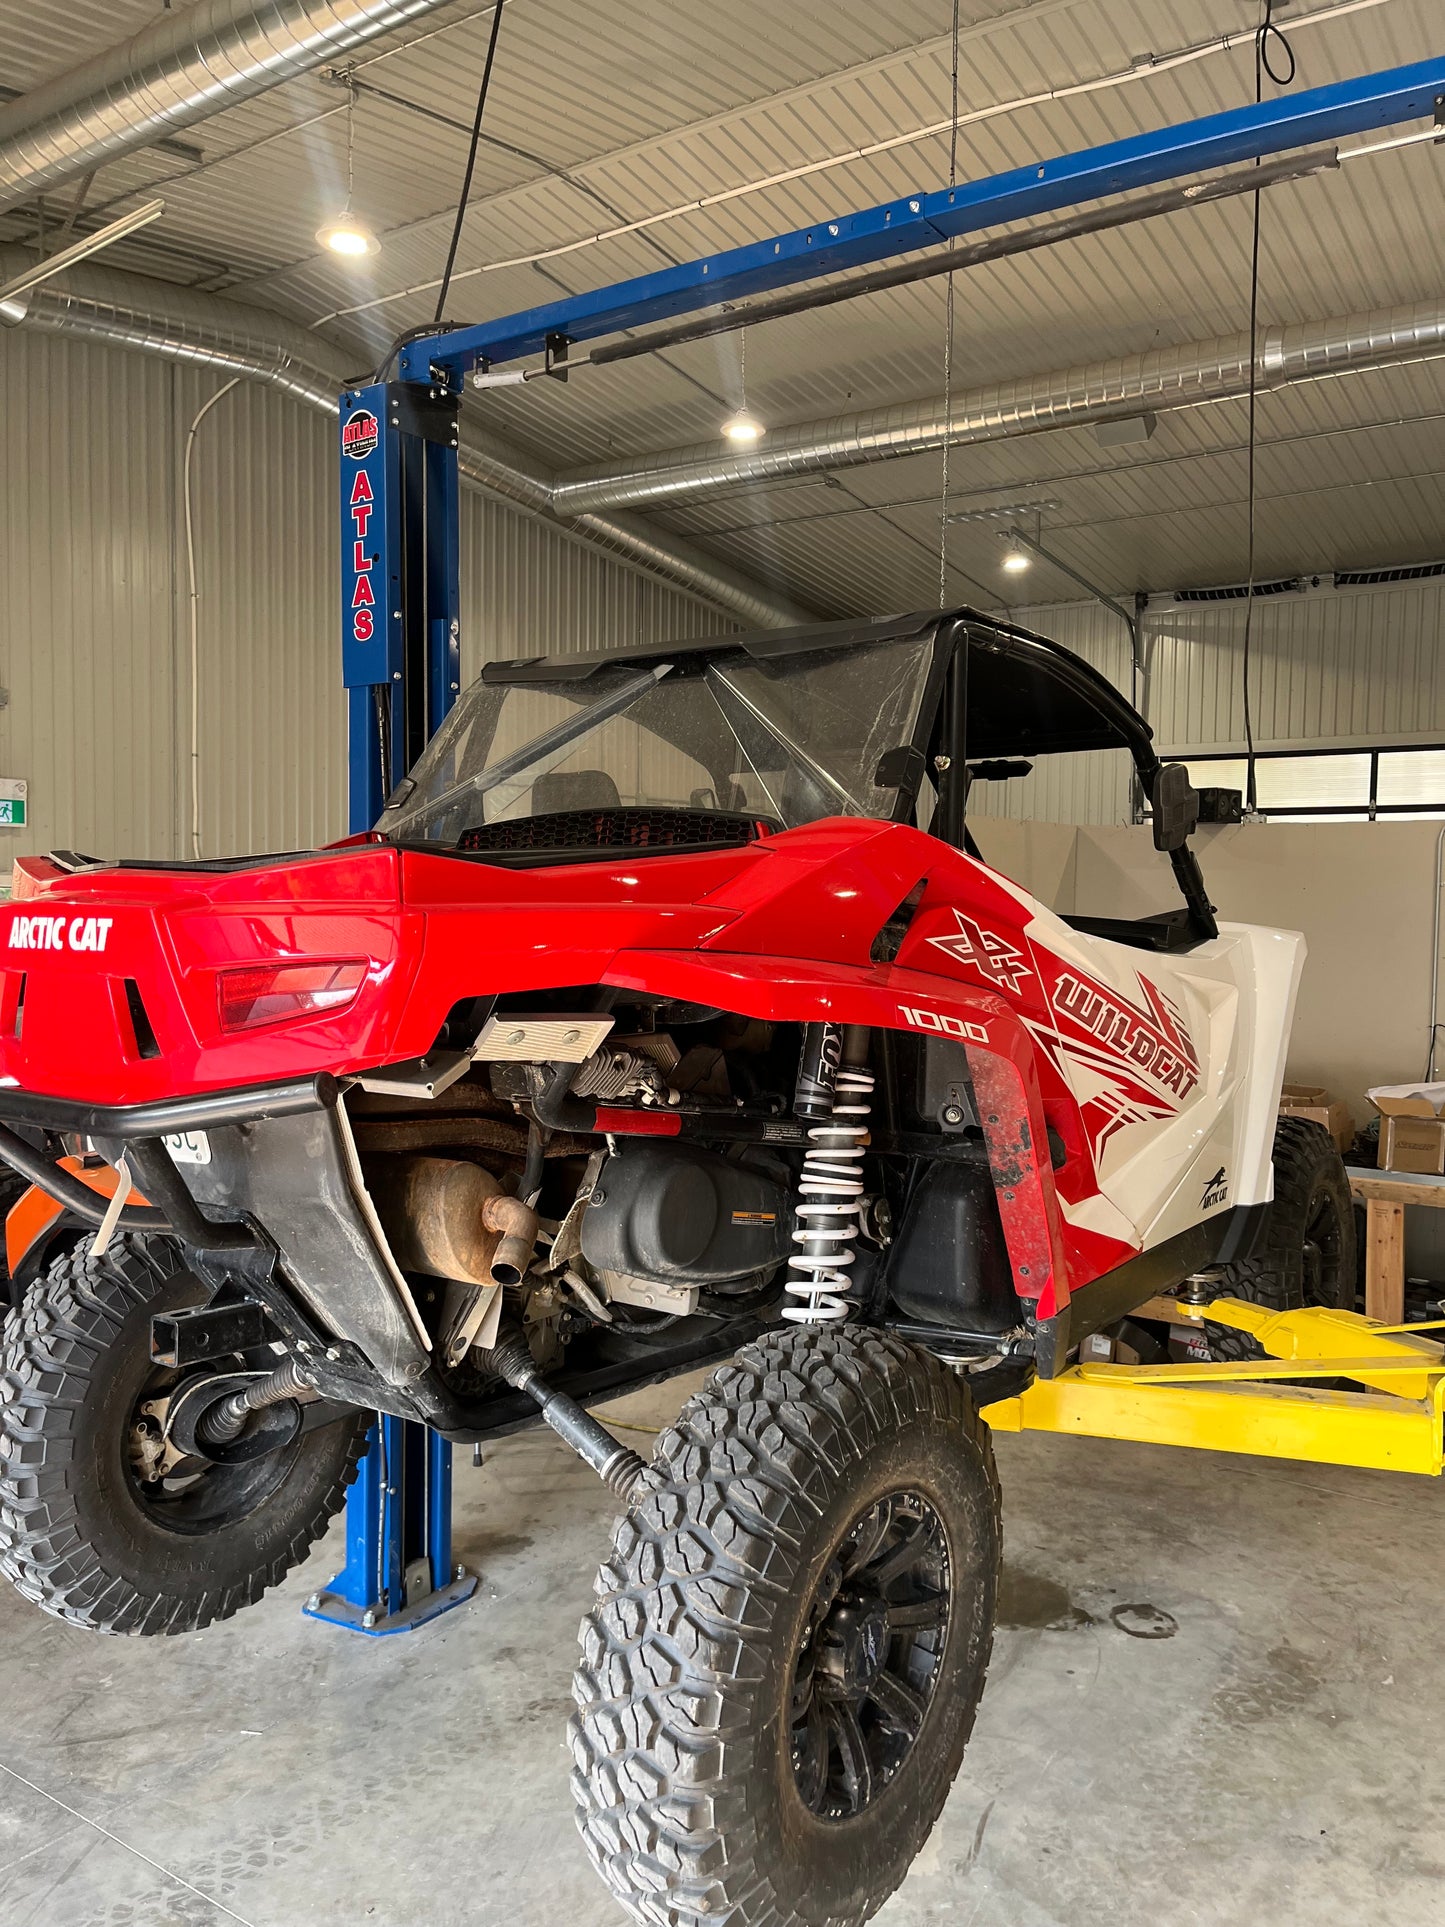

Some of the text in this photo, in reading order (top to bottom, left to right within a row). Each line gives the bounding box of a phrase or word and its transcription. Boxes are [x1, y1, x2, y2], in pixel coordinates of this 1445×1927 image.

[343, 417, 378, 444] ATLAS
[350, 469, 375, 642] ATLAS
[8, 916, 113, 952] ARCTIC CAT
[897, 1005, 990, 1044] 1000
[1051, 972, 1200, 1101] WILDCAT
